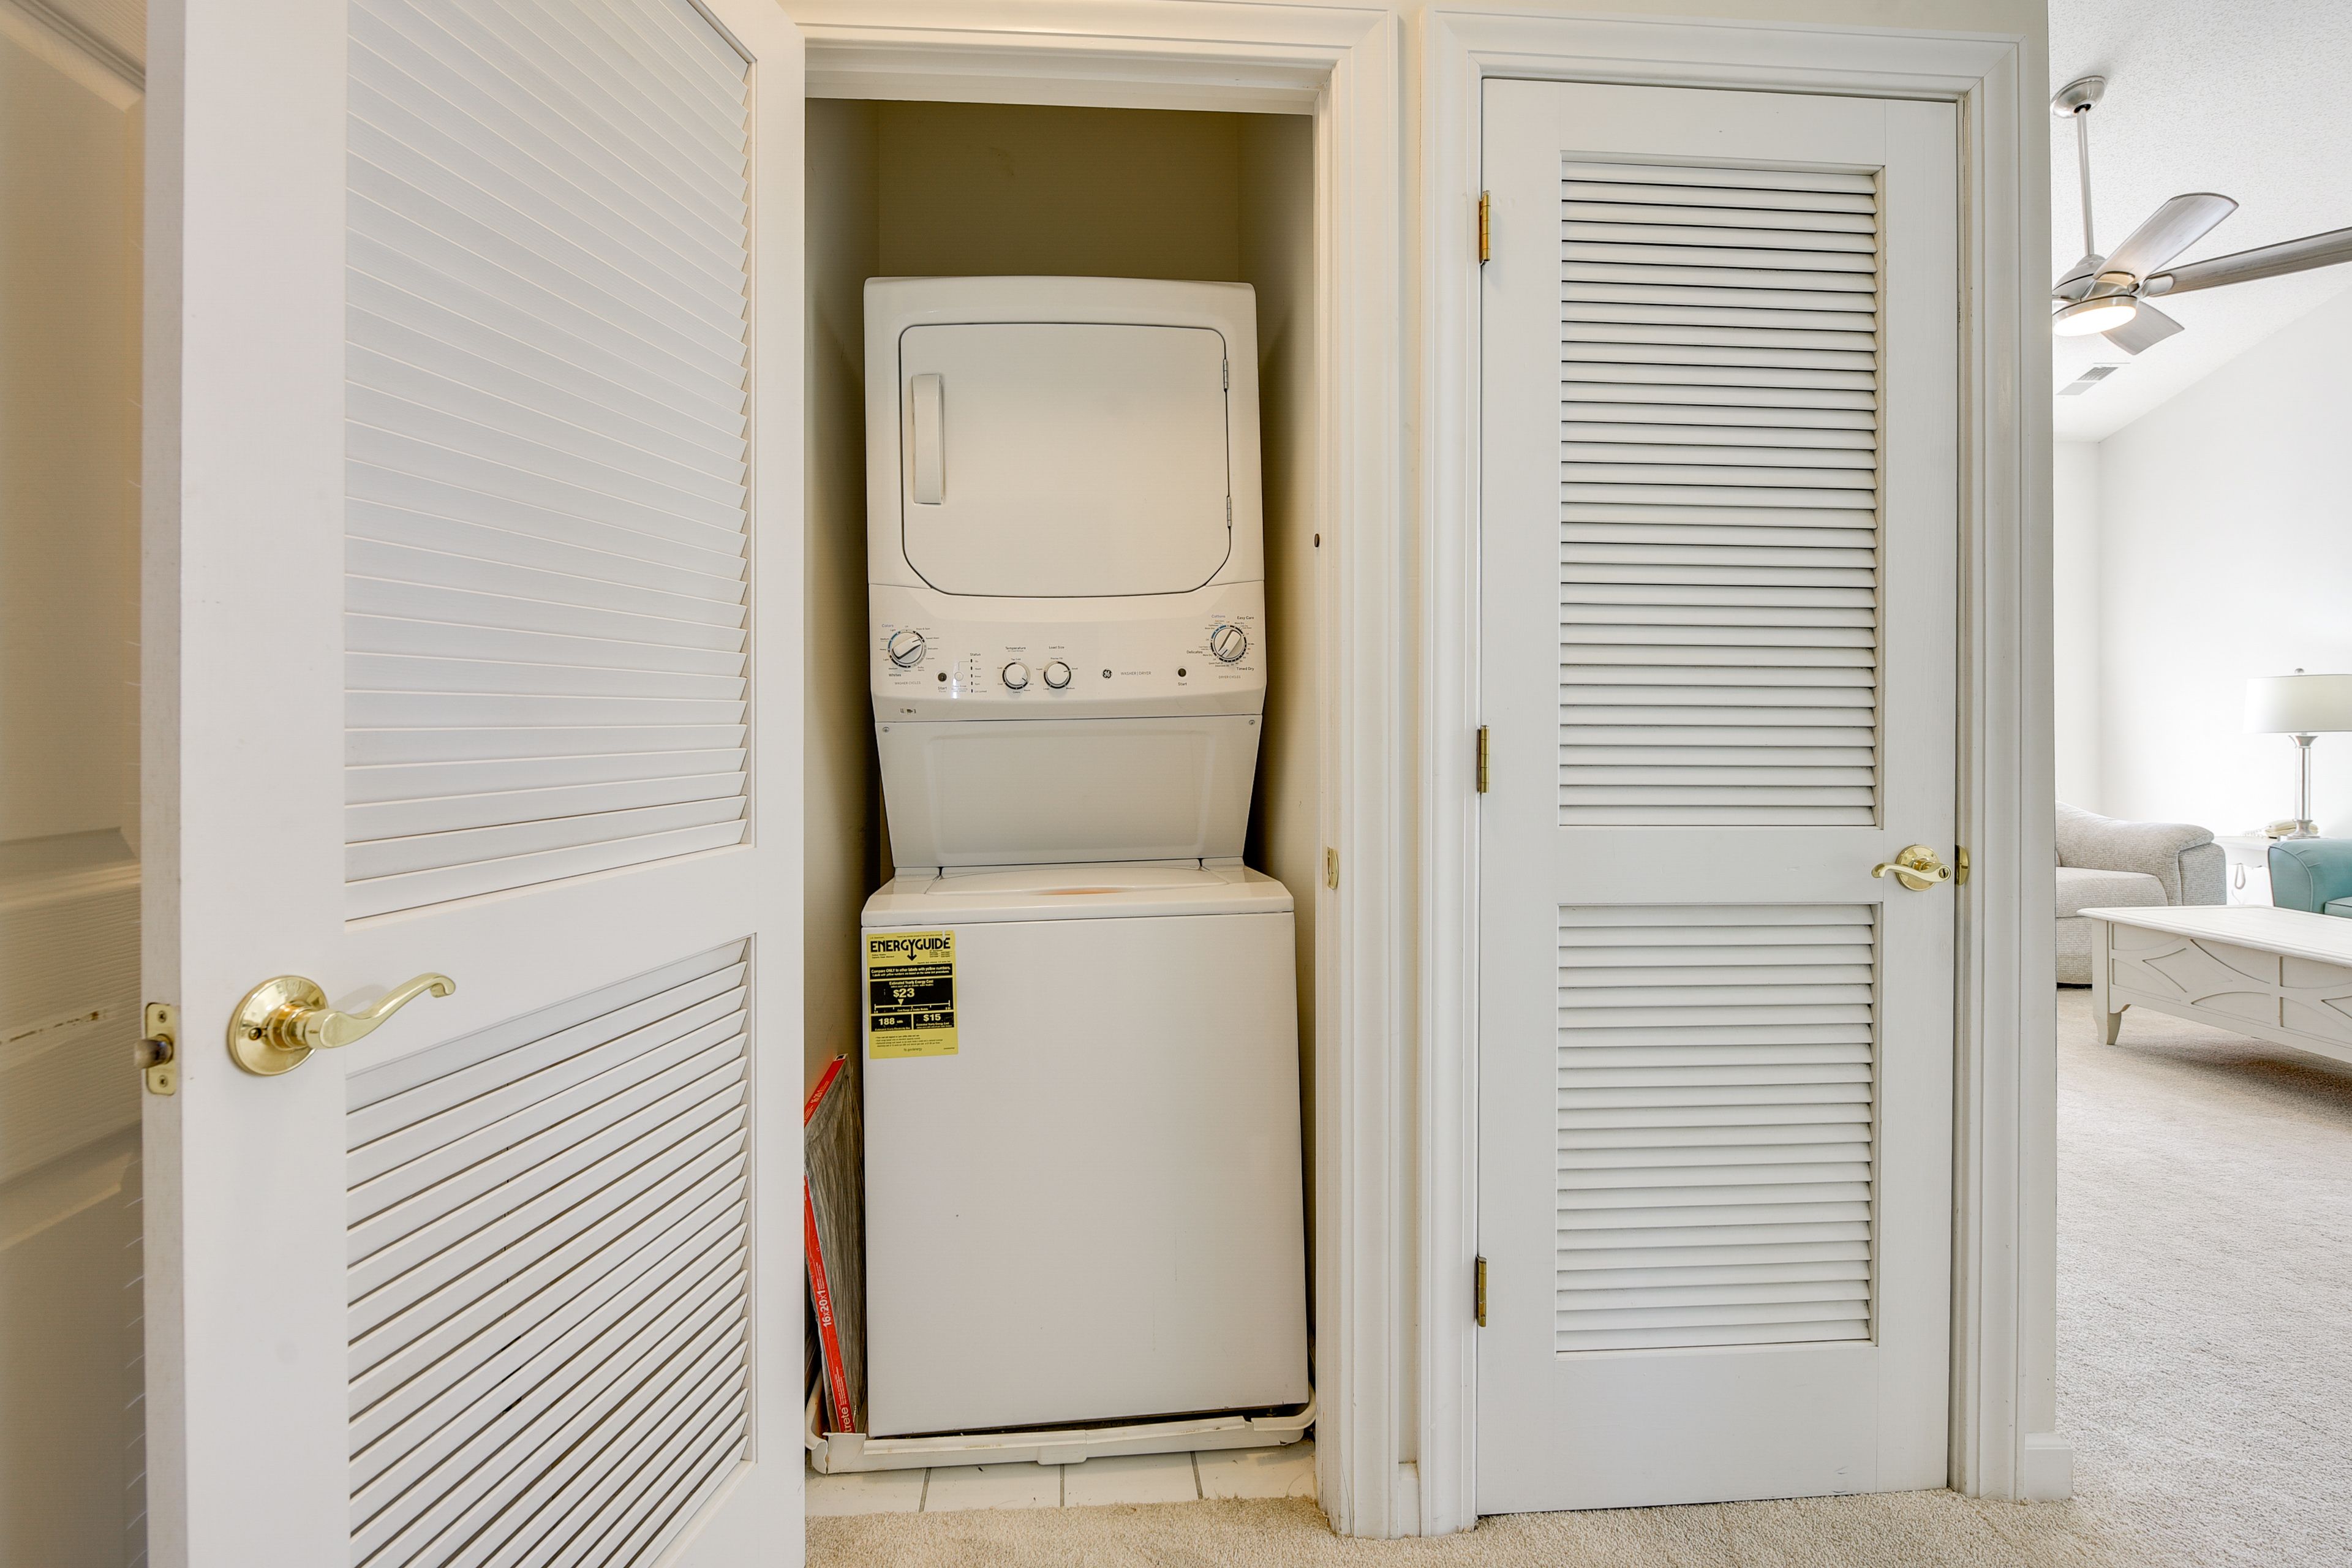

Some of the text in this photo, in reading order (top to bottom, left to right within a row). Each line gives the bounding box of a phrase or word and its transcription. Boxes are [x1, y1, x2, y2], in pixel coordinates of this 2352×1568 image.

[870, 937, 951, 954] ENERGYGUIDE
[893, 988, 915, 998] $23
[816, 1290, 832, 1328] 16x20x1
